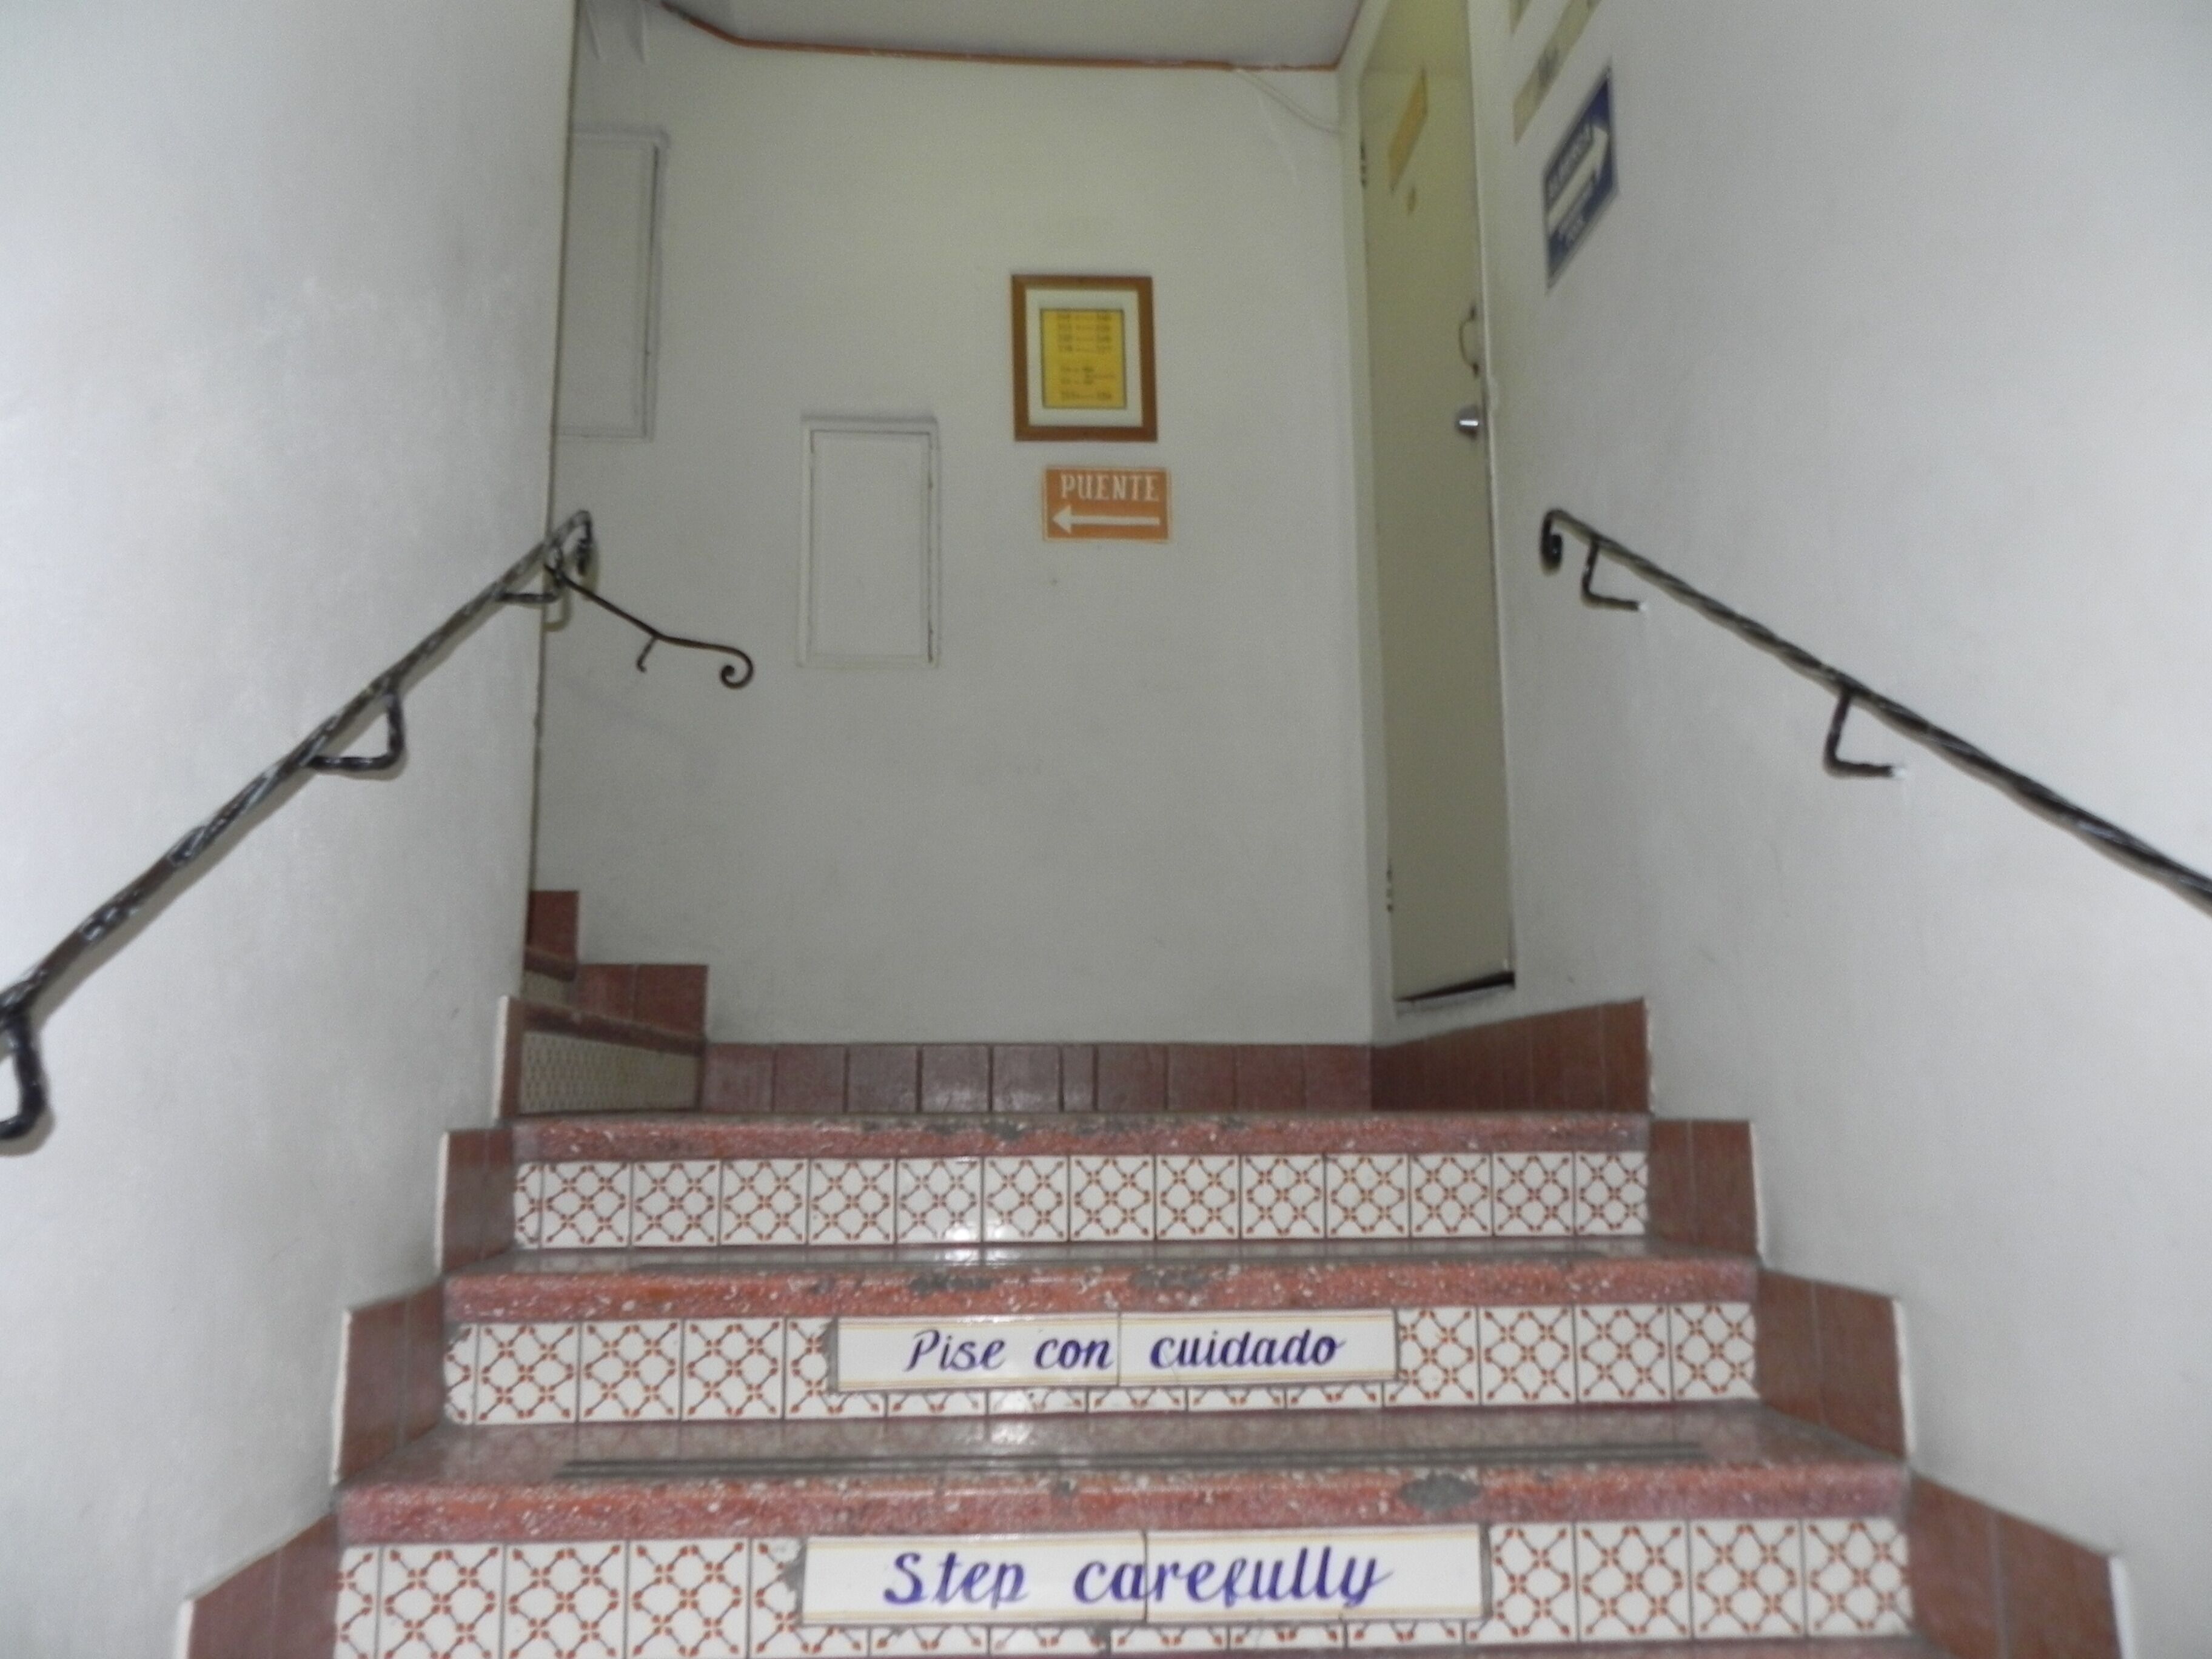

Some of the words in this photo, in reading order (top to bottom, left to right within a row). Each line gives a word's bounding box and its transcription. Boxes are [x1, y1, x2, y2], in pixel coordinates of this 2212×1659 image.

[1061, 474, 1160, 501] PUENTE
[904, 1328, 1006, 1372] Pise
[1034, 1337, 1113, 1370] con
[1150, 1328, 1346, 1369] cuidado
[883, 1550, 1028, 1609] Step
[1073, 1547, 1393, 1608] carefully
